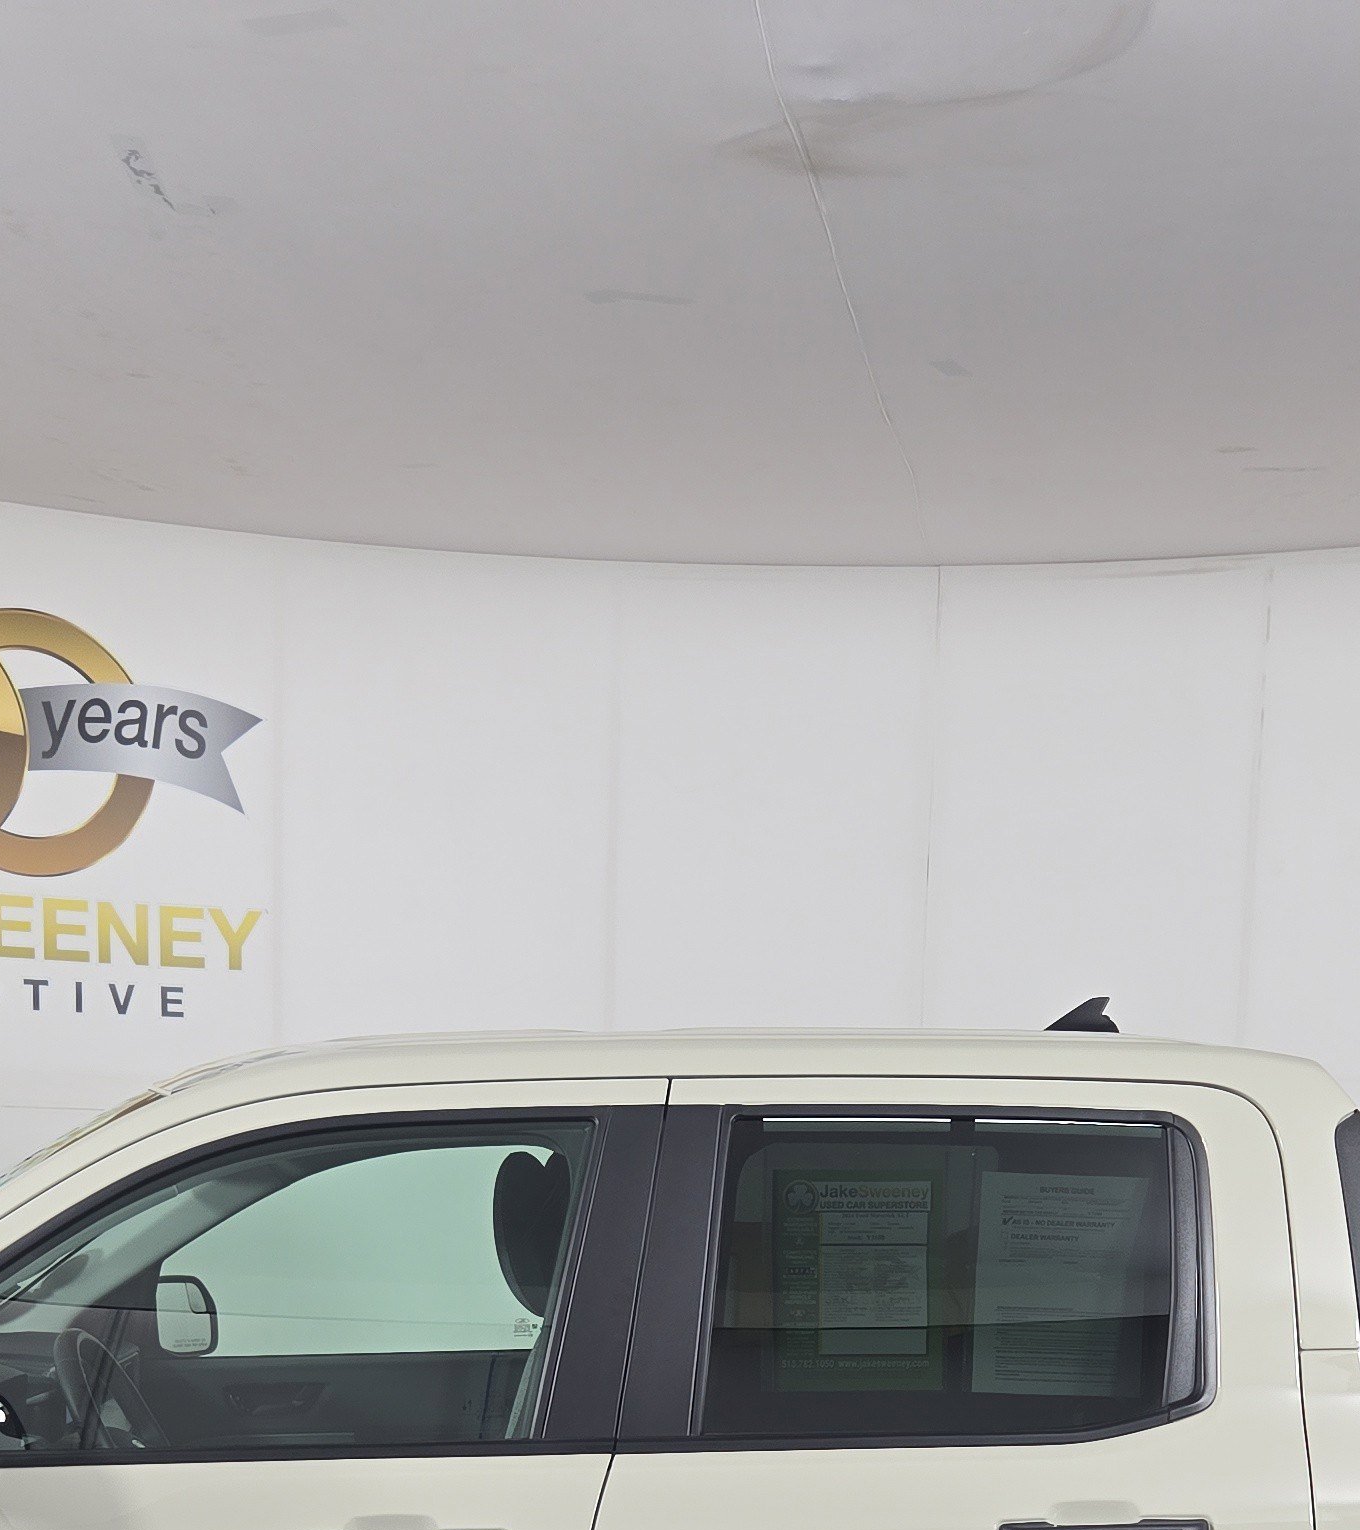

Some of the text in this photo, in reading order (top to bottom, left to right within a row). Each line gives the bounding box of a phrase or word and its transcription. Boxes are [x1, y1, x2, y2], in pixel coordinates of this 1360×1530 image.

[41, 698, 207, 759] years
[819, 1201, 929, 1209] USED CAR SUPERSTORE
